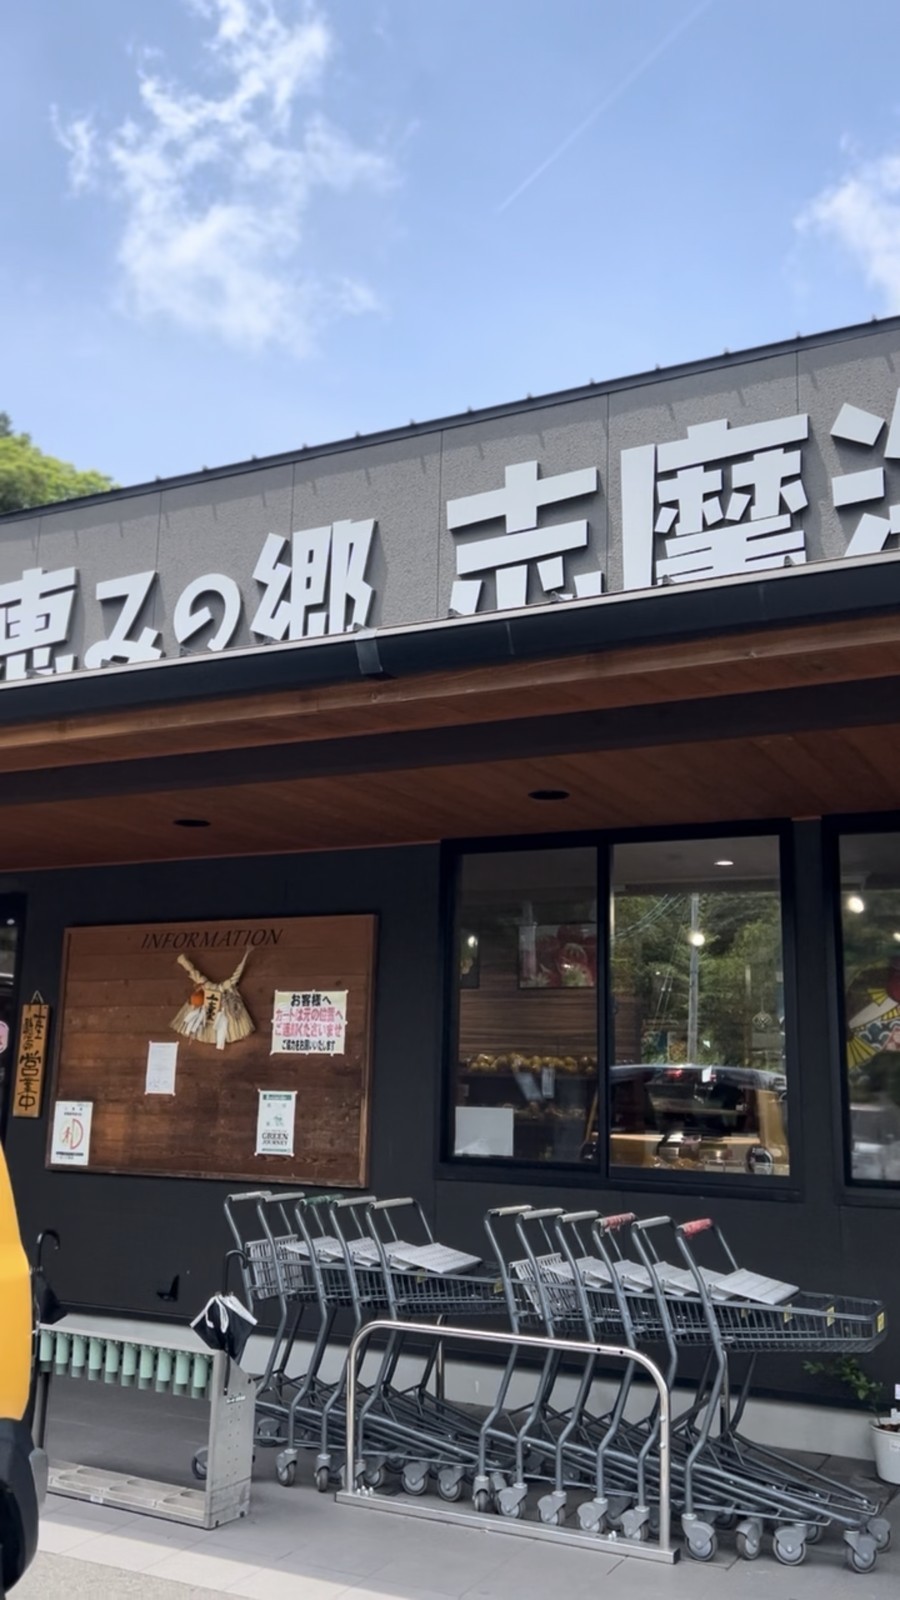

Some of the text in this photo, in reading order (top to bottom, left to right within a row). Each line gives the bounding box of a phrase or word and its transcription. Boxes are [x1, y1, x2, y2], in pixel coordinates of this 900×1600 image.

[141, 928, 283, 950] INFORMATION
[291, 993, 332, 1007] お客様へ
[17, 1050, 42, 1111] 営業中
[262, 1132, 288, 1140] GREEN
